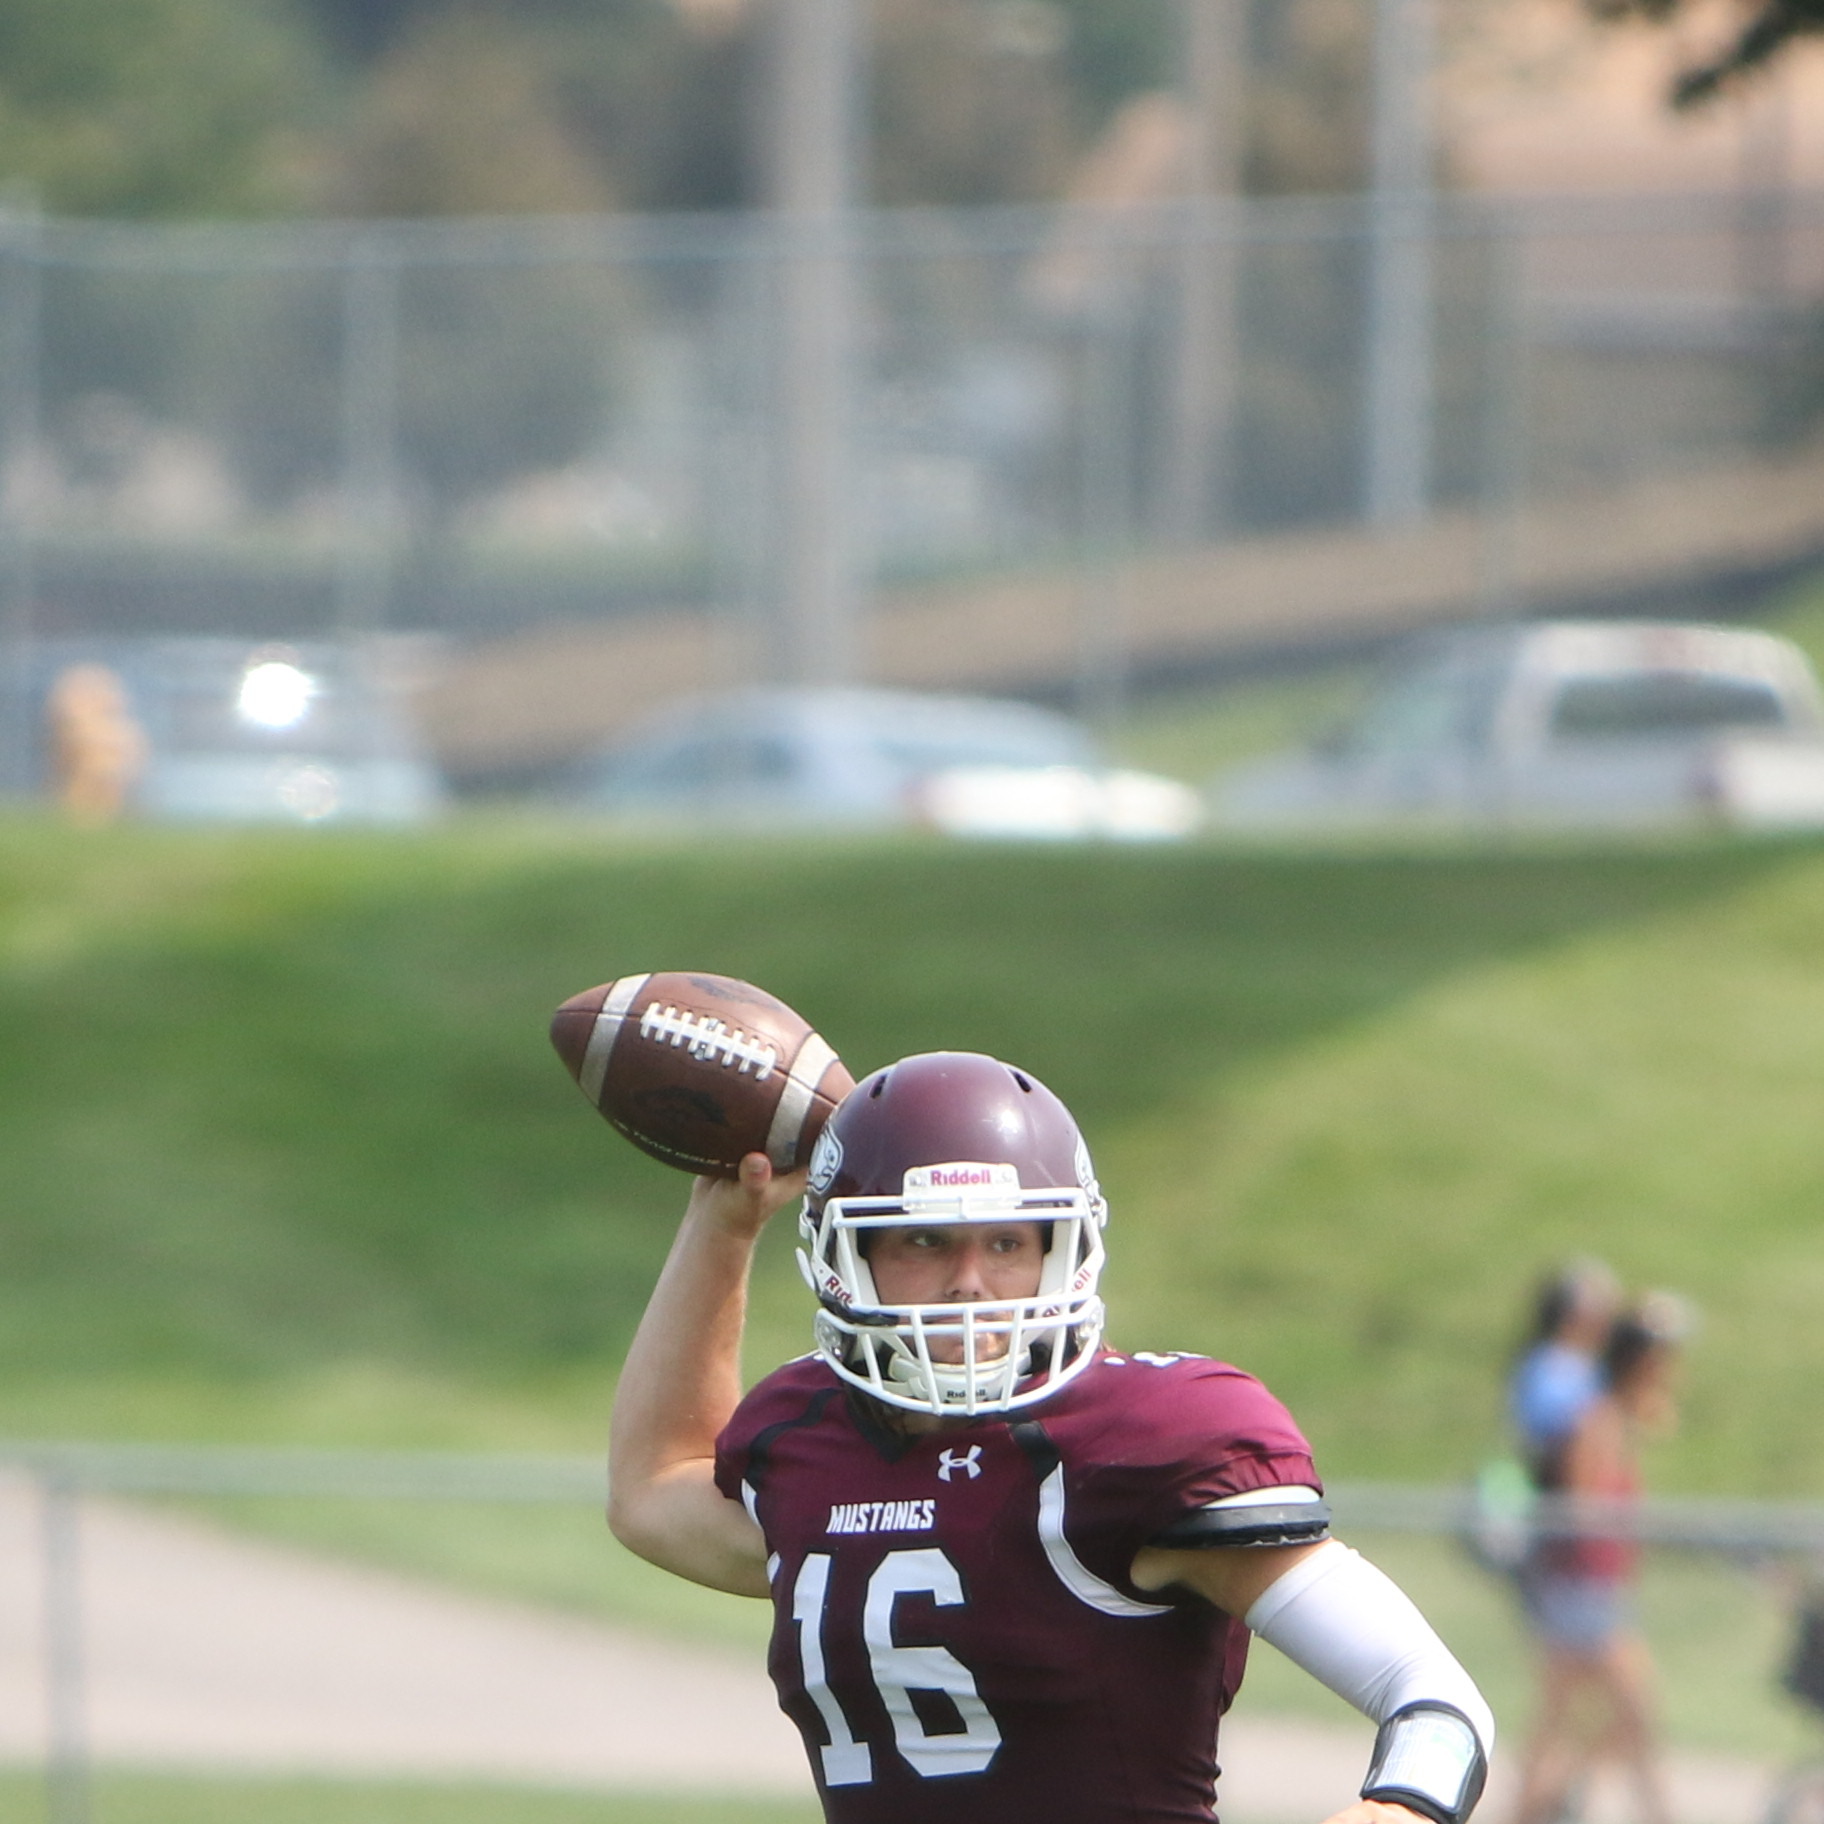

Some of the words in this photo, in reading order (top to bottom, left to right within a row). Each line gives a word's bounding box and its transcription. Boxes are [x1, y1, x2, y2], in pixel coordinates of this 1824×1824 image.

[930, 1168, 992, 1186] Riddell
[825, 1499, 936, 1534] MUSTANGS
[792, 1547, 1003, 1786] 16
